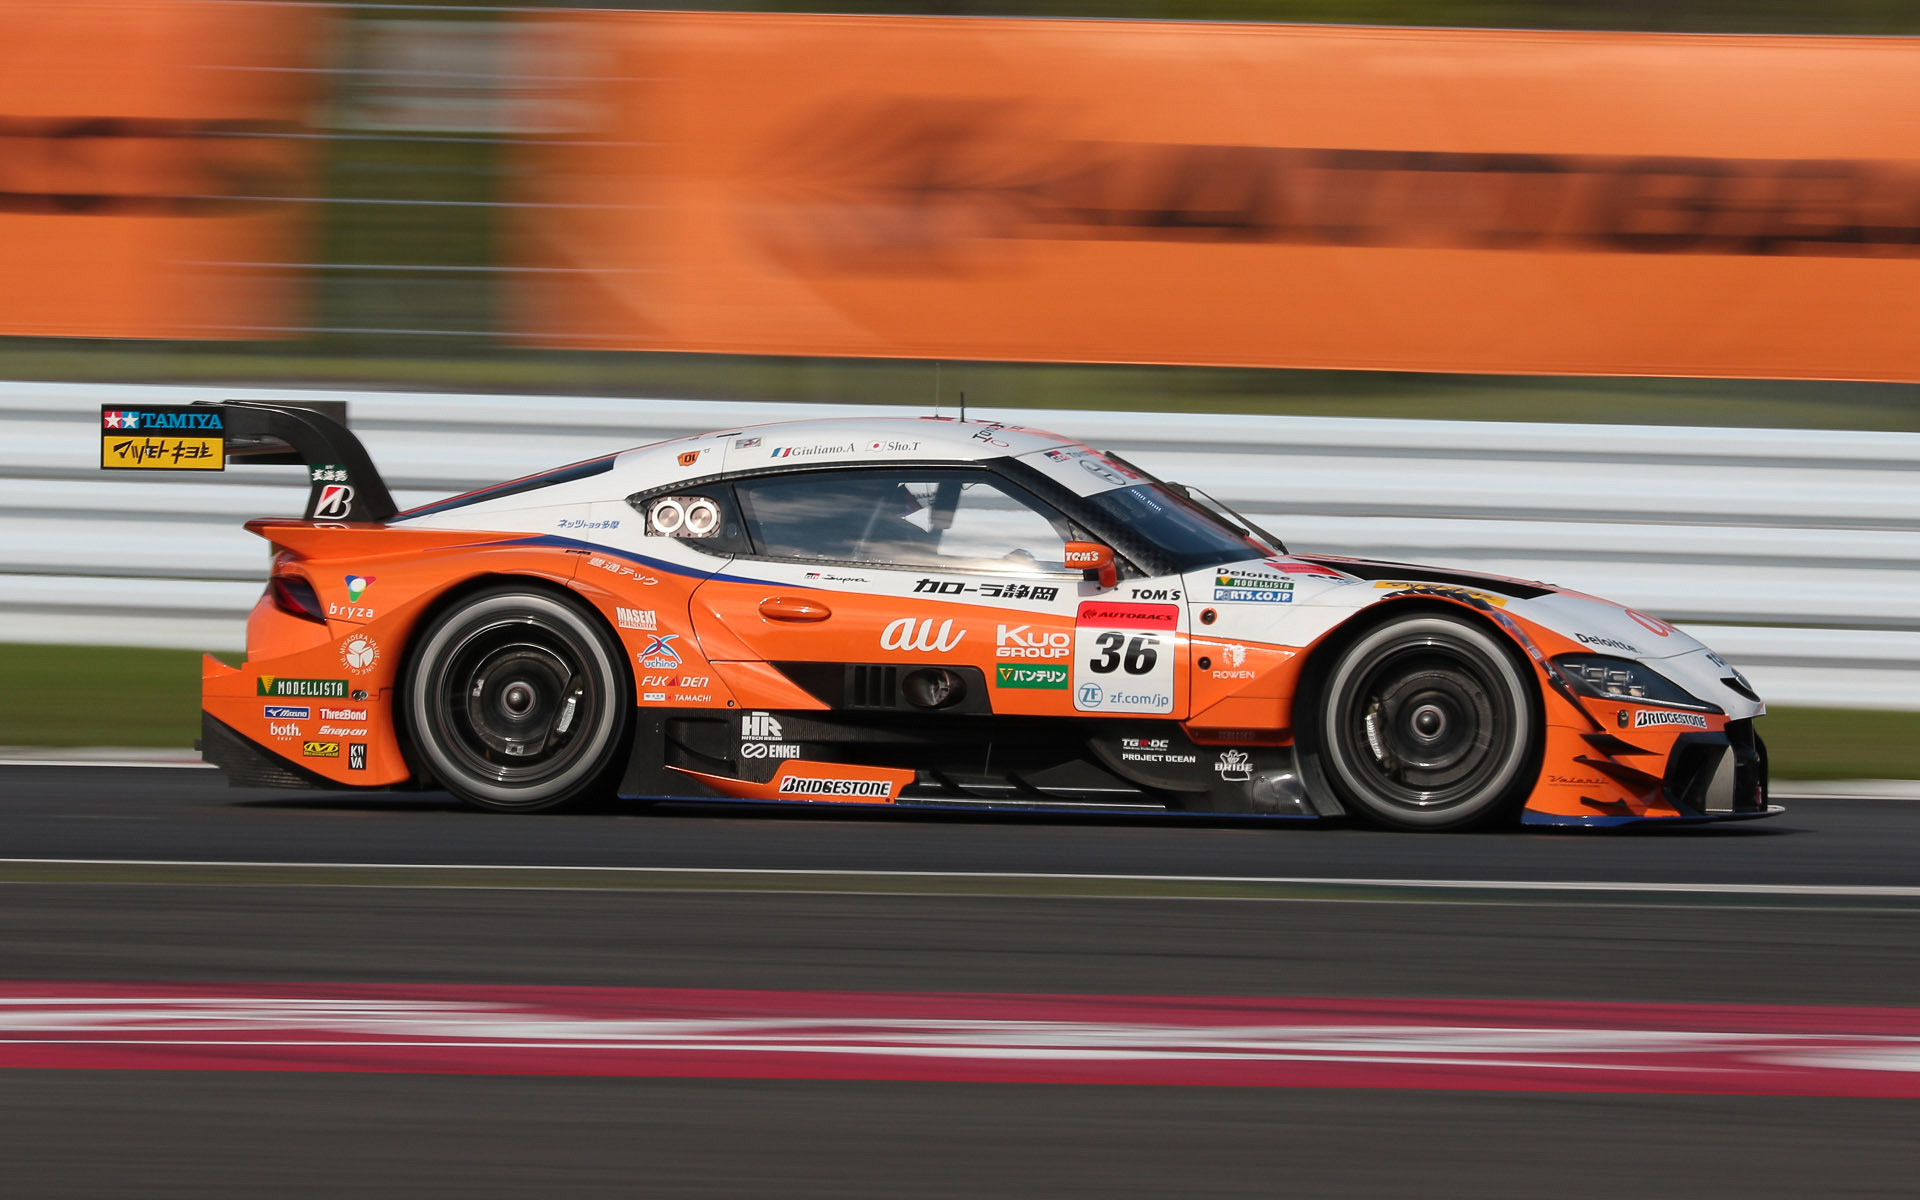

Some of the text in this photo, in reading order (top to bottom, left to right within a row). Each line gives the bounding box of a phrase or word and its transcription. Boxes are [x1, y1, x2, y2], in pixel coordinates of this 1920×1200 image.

[141, 413, 223, 429] TAMIYA
[792, 445, 855, 456] Giuliano.A
[887, 442, 921, 451] Sho.T
[823, 574, 871, 583] Supra
[1233, 579, 1290, 589] MODELLISTA
[913, 578, 1059, 601] カローラ静岡
[1132, 589, 1181, 600] TOM'S
[329, 603, 374, 618] bryza
[616, 606, 657, 624] MASEKI
[1099, 611, 1173, 621] AUTOBACS
[879, 617, 967, 652] au
[996, 647, 1069, 658] GROUP
[1089, 631, 1160, 675] 36
[644, 656, 677, 669] uchino
[1013, 670, 1067, 682] バンテリン
[1212, 670, 1255, 679] ROWEN
[277, 681, 343, 696] MODELLISTA
[1082, 688, 1100, 702] ZF
[675, 694, 711, 702] TAMACHI
[1110, 692, 1169, 707] zf.com/jp
[280, 709, 307, 718] Mizuno
[320, 708, 367, 721] ThreeBond
[1636, 711, 1707, 728] BRIDGESTONE
[270, 722, 302, 737] both.
[768, 745, 800, 759] ENKEI
[1122, 753, 1196, 763] PROJECT OCEAN
[1214, 762, 1253, 772] BRIDE
[781, 778, 891, 796] BRIDGESTONE
